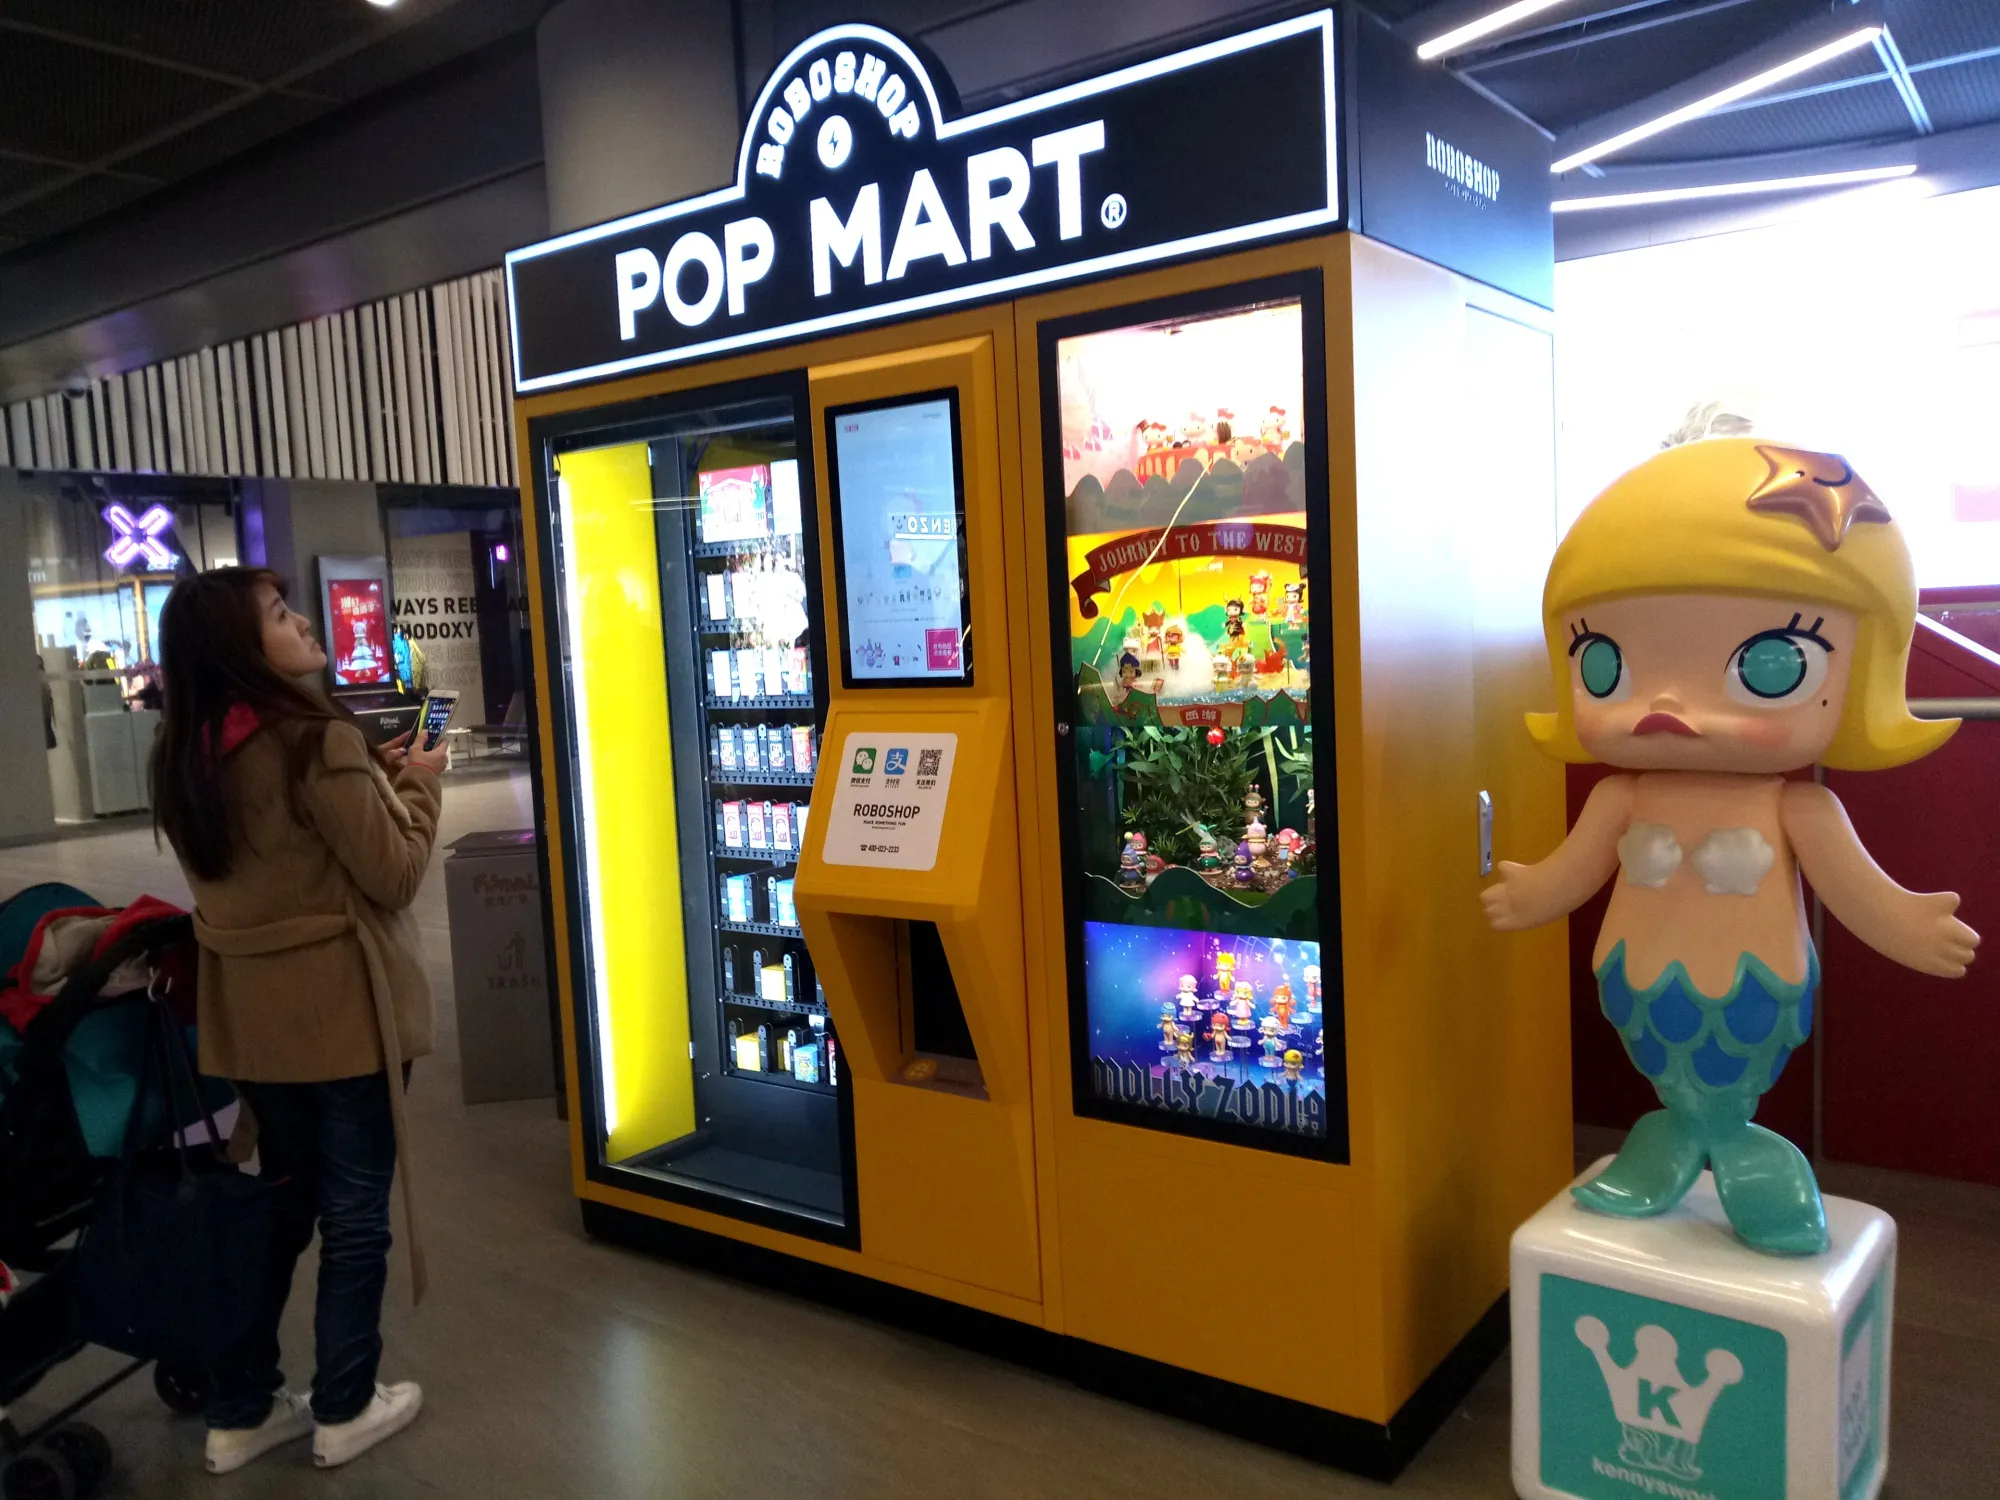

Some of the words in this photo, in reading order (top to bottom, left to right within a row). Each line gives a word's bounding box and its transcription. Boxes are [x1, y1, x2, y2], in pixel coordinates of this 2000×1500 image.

[756, 51, 921, 179] ROBOSHOP
[615, 214, 775, 341] POP
[809, 119, 1107, 298] MART
[1099, 537, 1168, 573] JOURNEY
[1175, 534, 1200, 553] TO
[1207, 530, 1247, 551] THE
[1254, 531, 1307, 557] WEST
[853, 803, 921, 820] ROBOSHOP
[487, 976, 541, 990] TRASH
[1093, 1055, 1205, 1114] MOLLY
[1637, 1377, 1683, 1430] K
